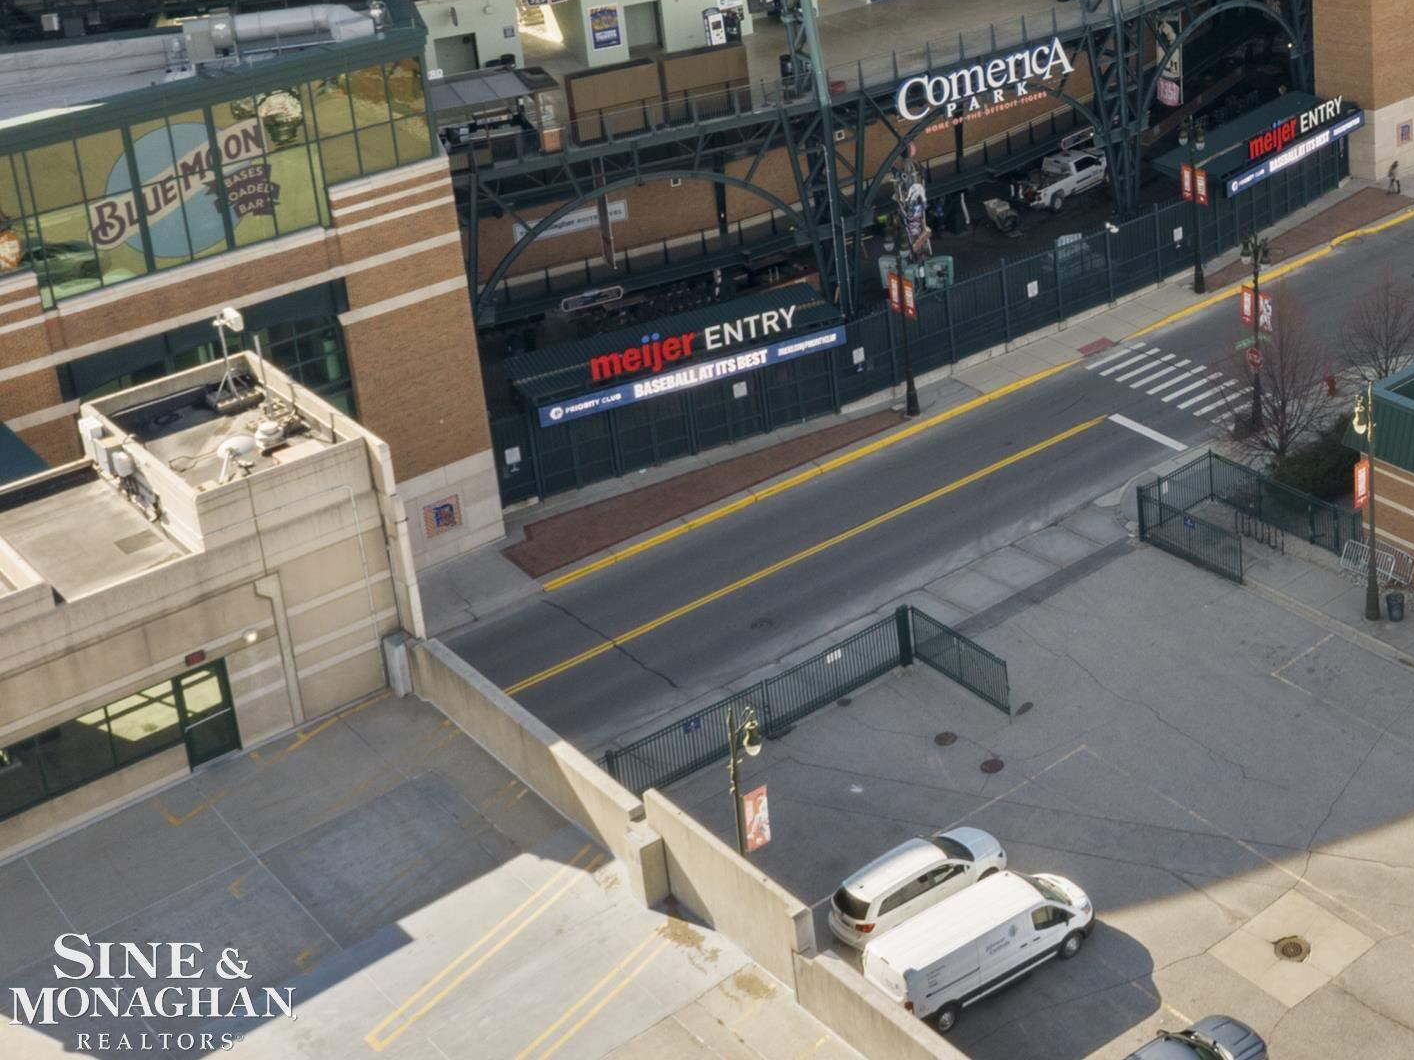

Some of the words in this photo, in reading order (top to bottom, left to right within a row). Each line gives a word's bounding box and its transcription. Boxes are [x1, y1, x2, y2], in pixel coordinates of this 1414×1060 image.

[925, 122, 949, 134] HOME
[952, 117, 963, 125] OF
[967, 111, 983, 121] THE
[985, 100, 1017, 116] DETROIT
[1021, 91, 1048, 104] TIGERS
[947, 81, 1029, 118] PARK
[1248, 120, 1297, 160] meijer
[1300, 95, 1342, 133] ENTRY
[225, 167, 263, 188] BASES
[94, 174, 178, 245] BLUE
[239, 199, 264, 213] BAR
[590, 332, 698, 381] meijer
[704, 305, 797, 350] ENTRY
[565, 399, 600, 414] PRIORITY
[601, 392, 622, 404] CLUB
[634, 371, 698, 399] BASEBALL
[697, 362, 715, 381] AT
[715, 358, 736, 376] ITS
[736, 349, 768, 370] BEST
